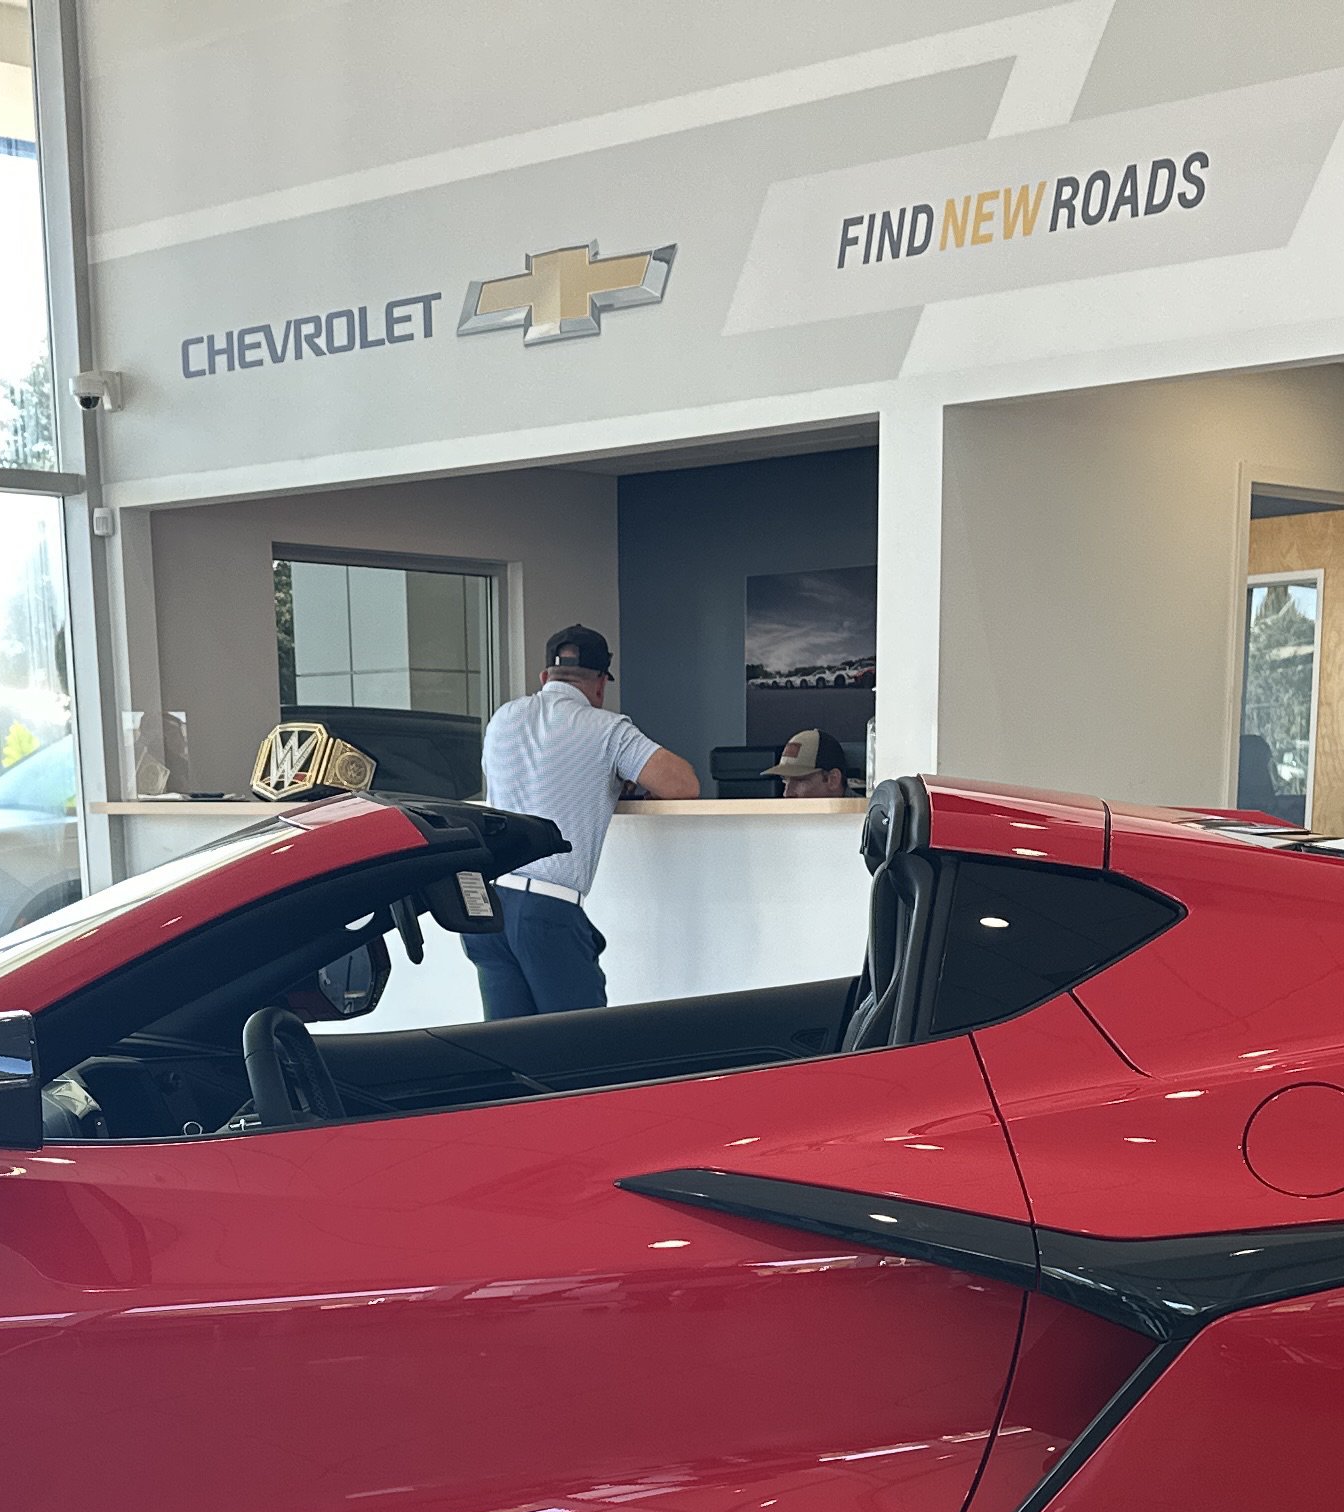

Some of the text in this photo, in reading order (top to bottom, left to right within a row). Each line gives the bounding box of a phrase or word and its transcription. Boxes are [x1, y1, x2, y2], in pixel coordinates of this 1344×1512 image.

[836, 150, 1210, 269] FIND NEW ROADS
[181, 292, 442, 380] CHEVROLET
